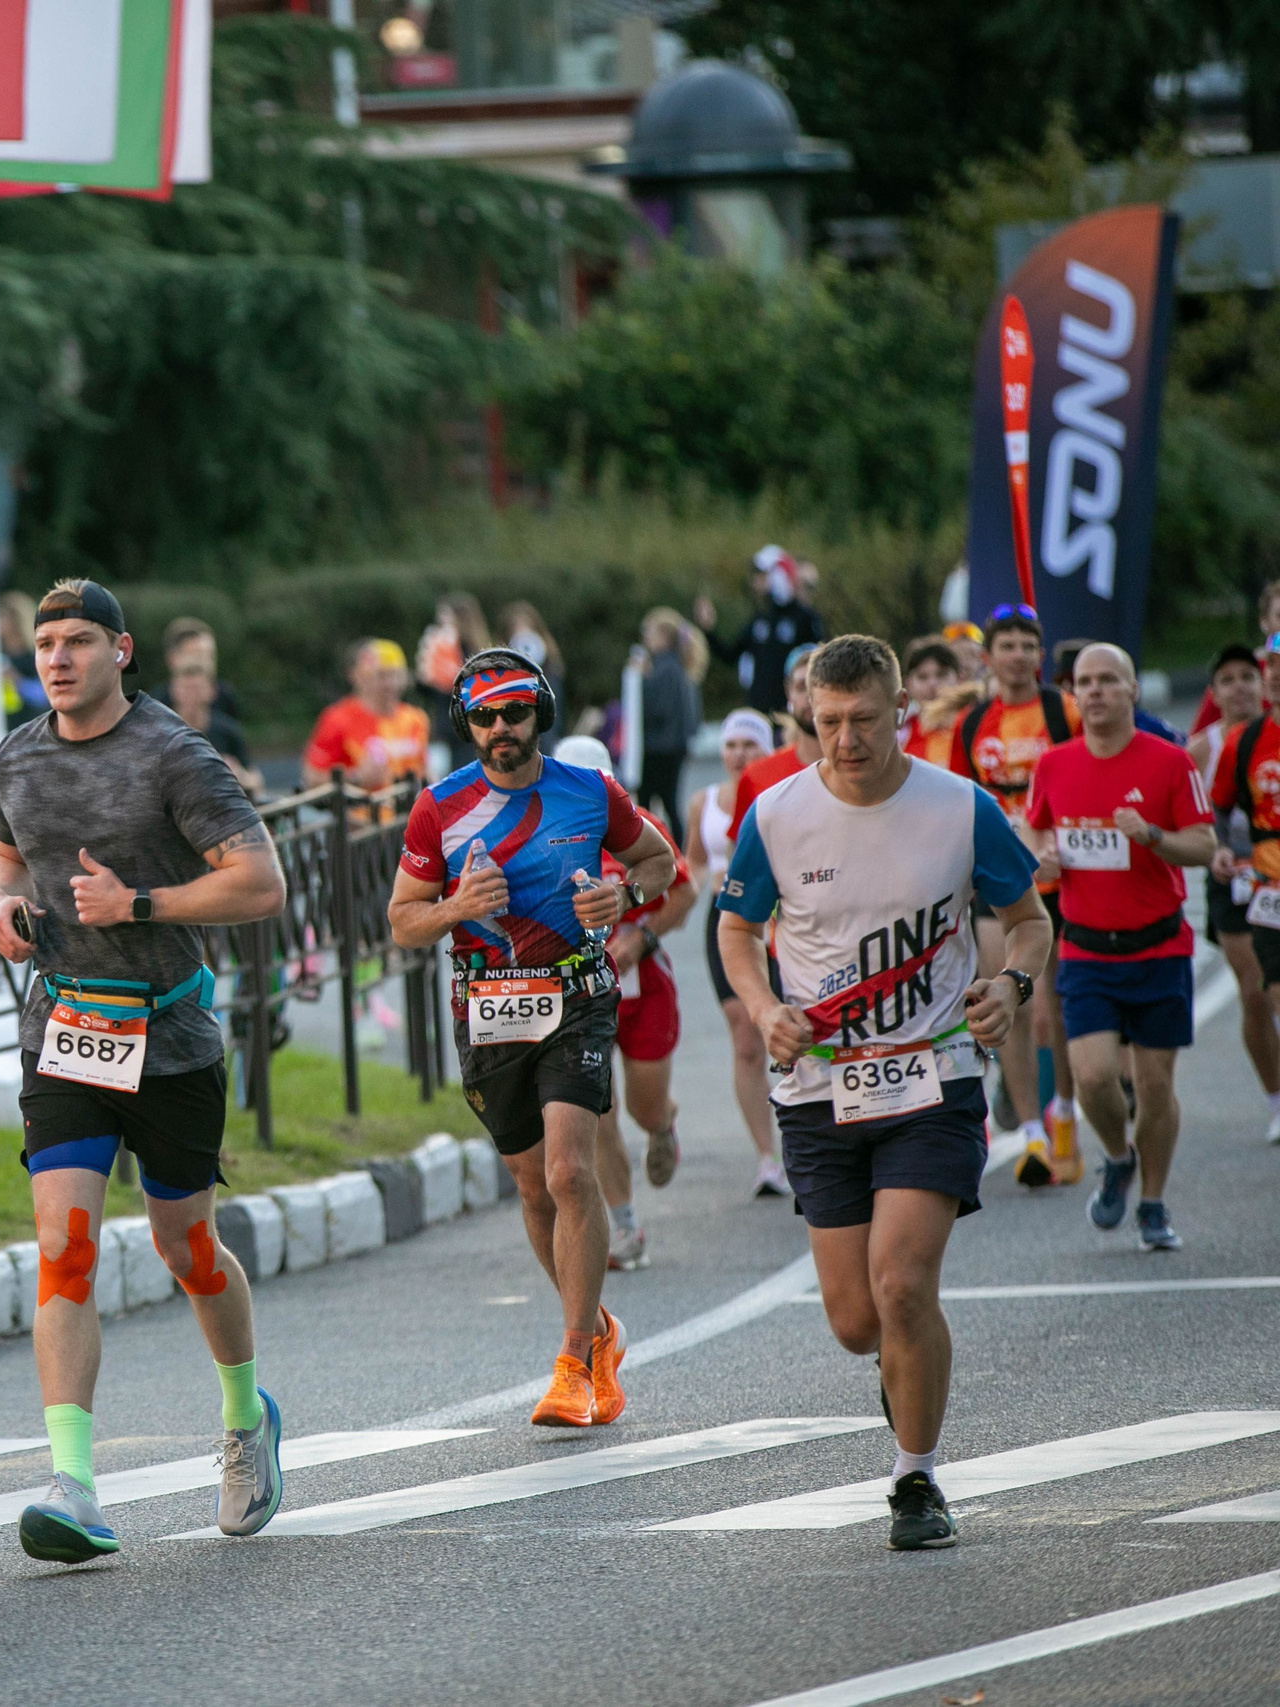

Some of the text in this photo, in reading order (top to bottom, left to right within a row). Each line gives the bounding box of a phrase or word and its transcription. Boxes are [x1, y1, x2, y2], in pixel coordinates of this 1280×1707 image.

[1067, 830, 1118, 851] 6531
[859, 892, 954, 982] ONE
[485, 967, 551, 979] NUTREND
[818, 963, 858, 999] 2022
[479, 996, 554, 1021] 6458
[840, 960, 933, 1048] RUN
[501, 1018, 531, 1026] АЛЕКСЕЙ
[57, 1031, 135, 1064] 6687
[842, 1054, 928, 1092] 6364
[862, 1085, 908, 1098] АЛЕКСАНДР
[845, 1110, 853, 1120] D
